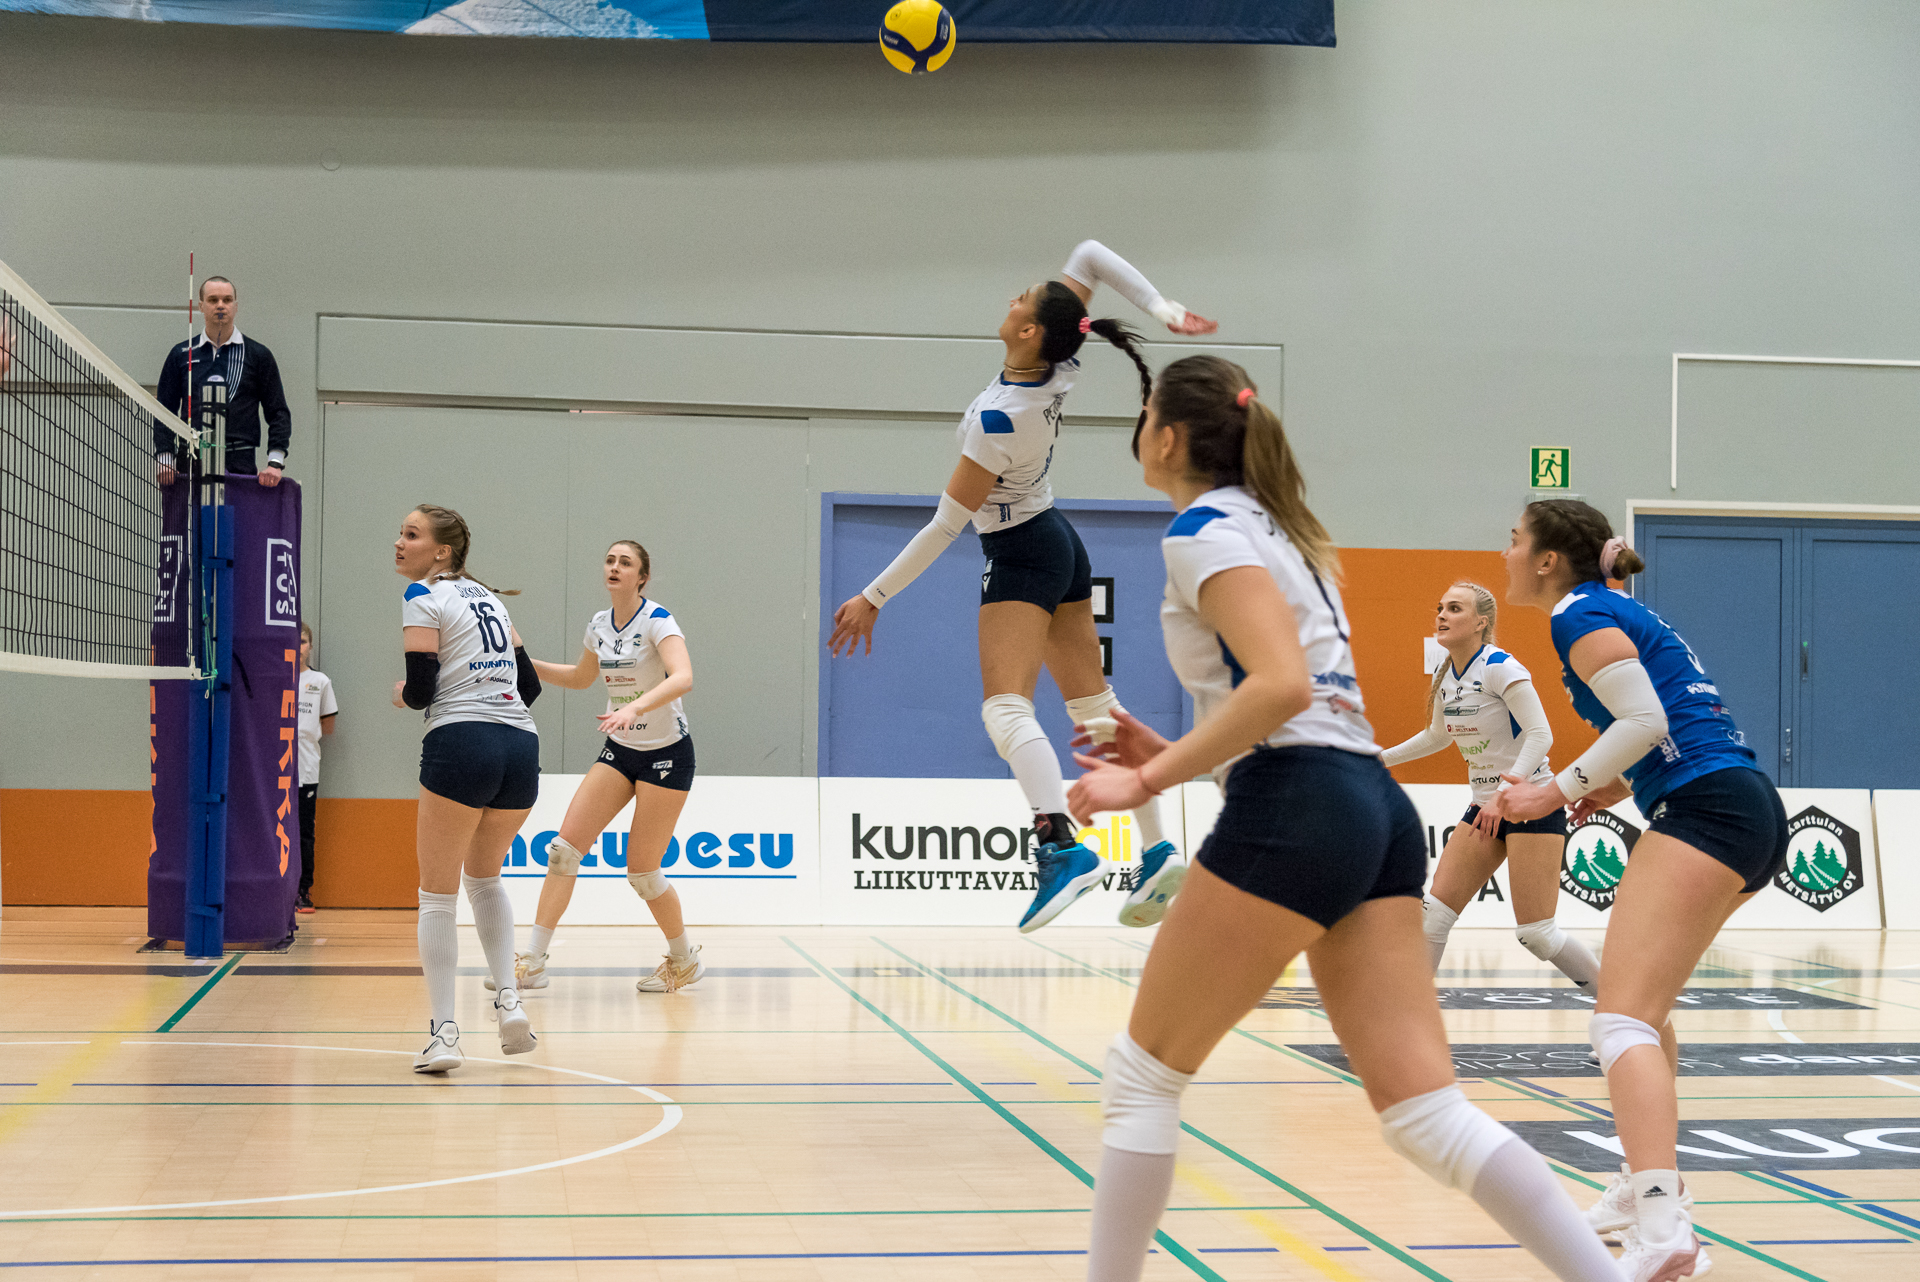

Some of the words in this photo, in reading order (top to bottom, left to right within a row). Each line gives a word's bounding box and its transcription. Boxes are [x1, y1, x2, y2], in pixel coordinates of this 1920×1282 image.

[469, 602, 508, 654] 16
[852, 813, 1131, 862] kunnonali
[1788, 815, 1843, 836] Karttulan
[1779, 871, 1843, 904] METSÄTYÖ
[1842, 870, 1857, 890] OY
